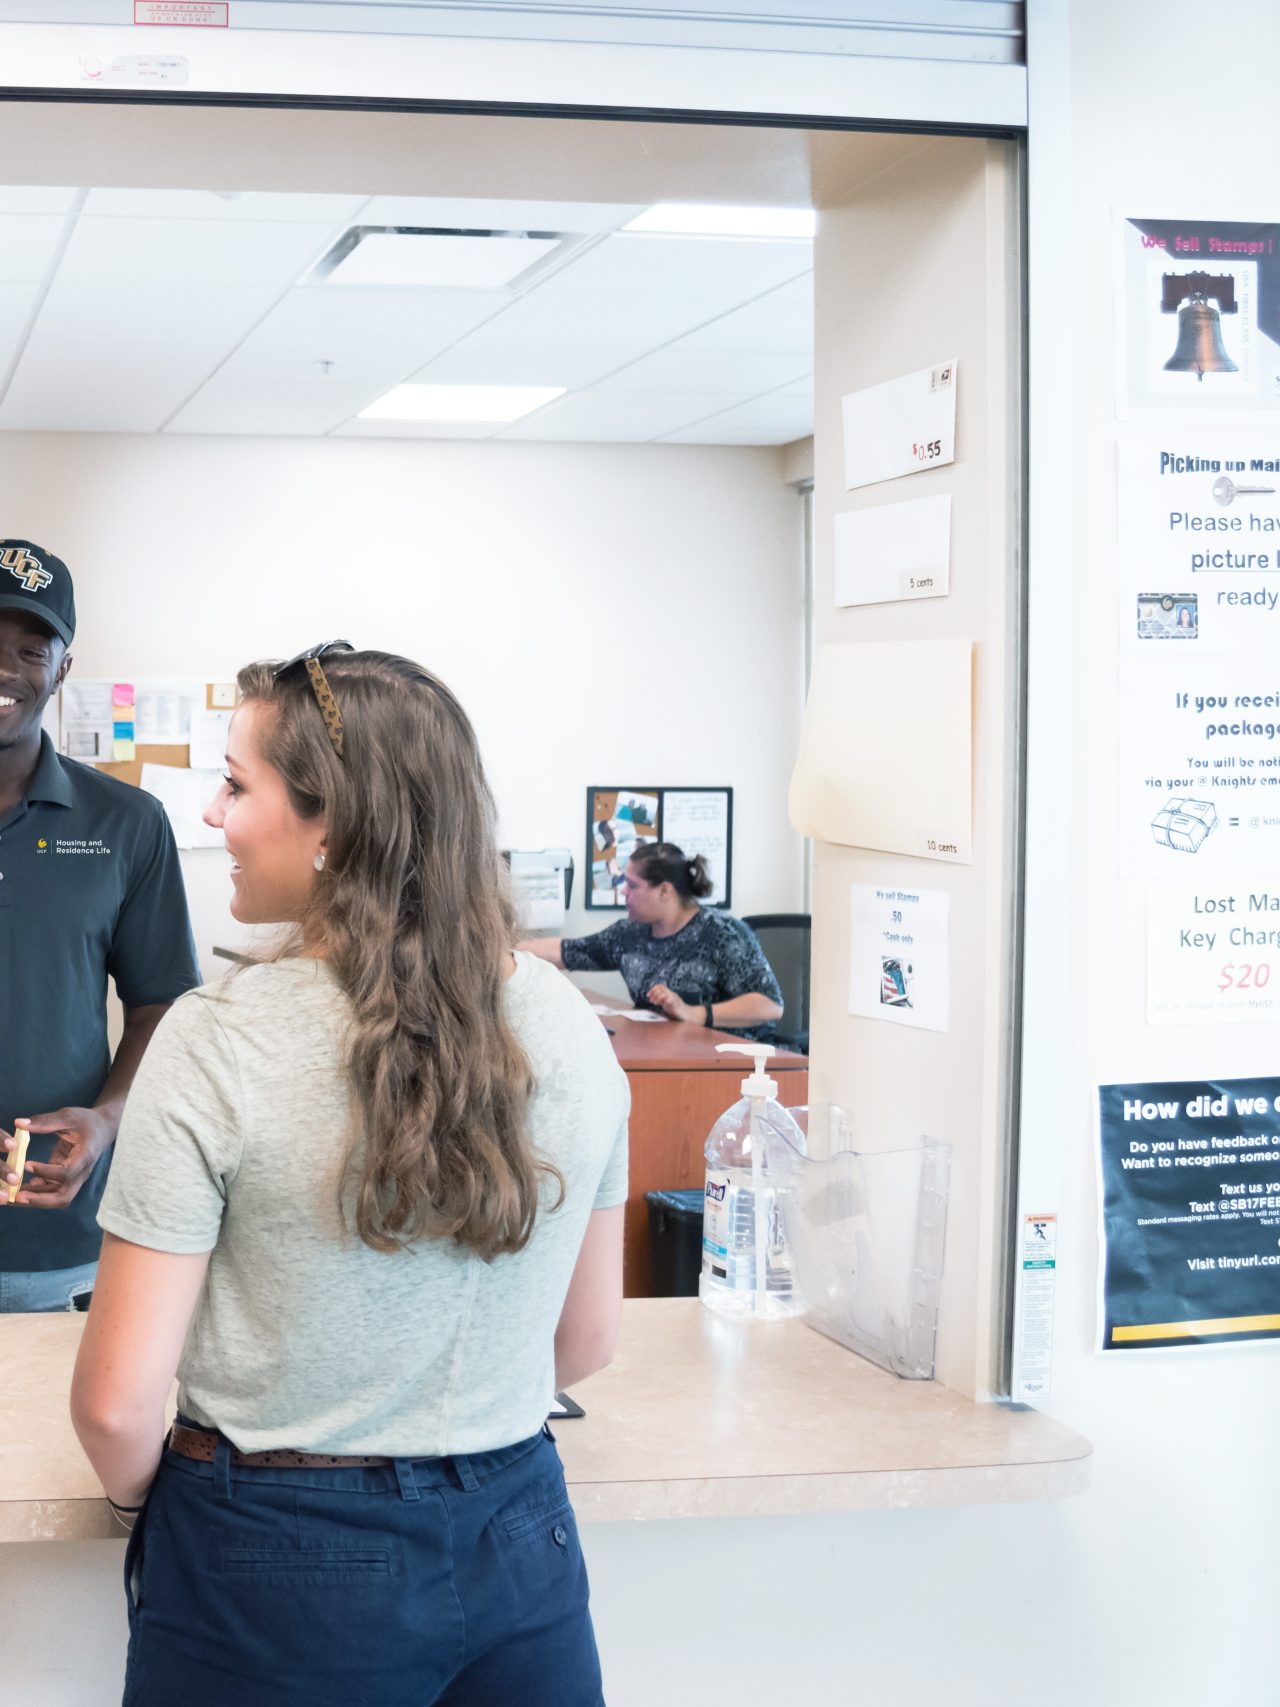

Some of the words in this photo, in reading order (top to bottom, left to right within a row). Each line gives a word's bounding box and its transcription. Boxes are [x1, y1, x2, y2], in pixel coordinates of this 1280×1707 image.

[1141, 235, 1166, 248] We
[1175, 236, 1200, 251] Sell
[1160, 452, 1220, 475] Picking
[1225, 460, 1245, 472] up
[1170, 512, 1242, 531] Please
[1192, 549, 1269, 572] picture
[910, 578, 914, 588] 5
[917, 578, 933, 588] cents
[1217, 587, 1279, 610] ready
[1176, 693, 1188, 708] If
[1195, 696, 1227, 713] you
[1235, 692, 1280, 708] recei
[1188, 757, 1209, 768] You
[1213, 757, 1235, 767] will
[1239, 757, 1254, 767] be
[1145, 776, 1162, 787] via
[1167, 779, 1193, 790] your
[1212, 776, 1257, 789] Knights
[928, 840, 936, 850] 10
[938, 843, 957, 853] cents
[876, 890, 884, 899] We
[897, 892, 920, 903] Stamps
[1194, 896, 1235, 913] Lost
[1249, 894, 1280, 911] Ma
[901, 935, 913, 944] only
[1180, 929, 1216, 951] Key
[1218, 960, 1270, 994] $20
[1124, 1099, 1179, 1120] How
[1186, 1095, 1228, 1118] did
[1234, 1097, 1268, 1115] we
[1130, 1141, 1148, 1153] Do
[1152, 1140, 1174, 1153] you
[1178, 1138, 1208, 1150] have
[1211, 1134, 1268, 1148] feedback
[1121, 1157, 1155, 1170] Want
[1158, 1157, 1171, 1167] to
[1175, 1153, 1236, 1167] recognize
[1240, 1151, 1280, 1163] someo
[1220, 1184, 1245, 1195] Text
[1249, 1184, 1262, 1193] us
[1189, 1201, 1215, 1213] Text
[1137, 1217, 1166, 1225] Standard
[1168, 1215, 1202, 1223] messaging
[1187, 1258, 1215, 1270] Visit
